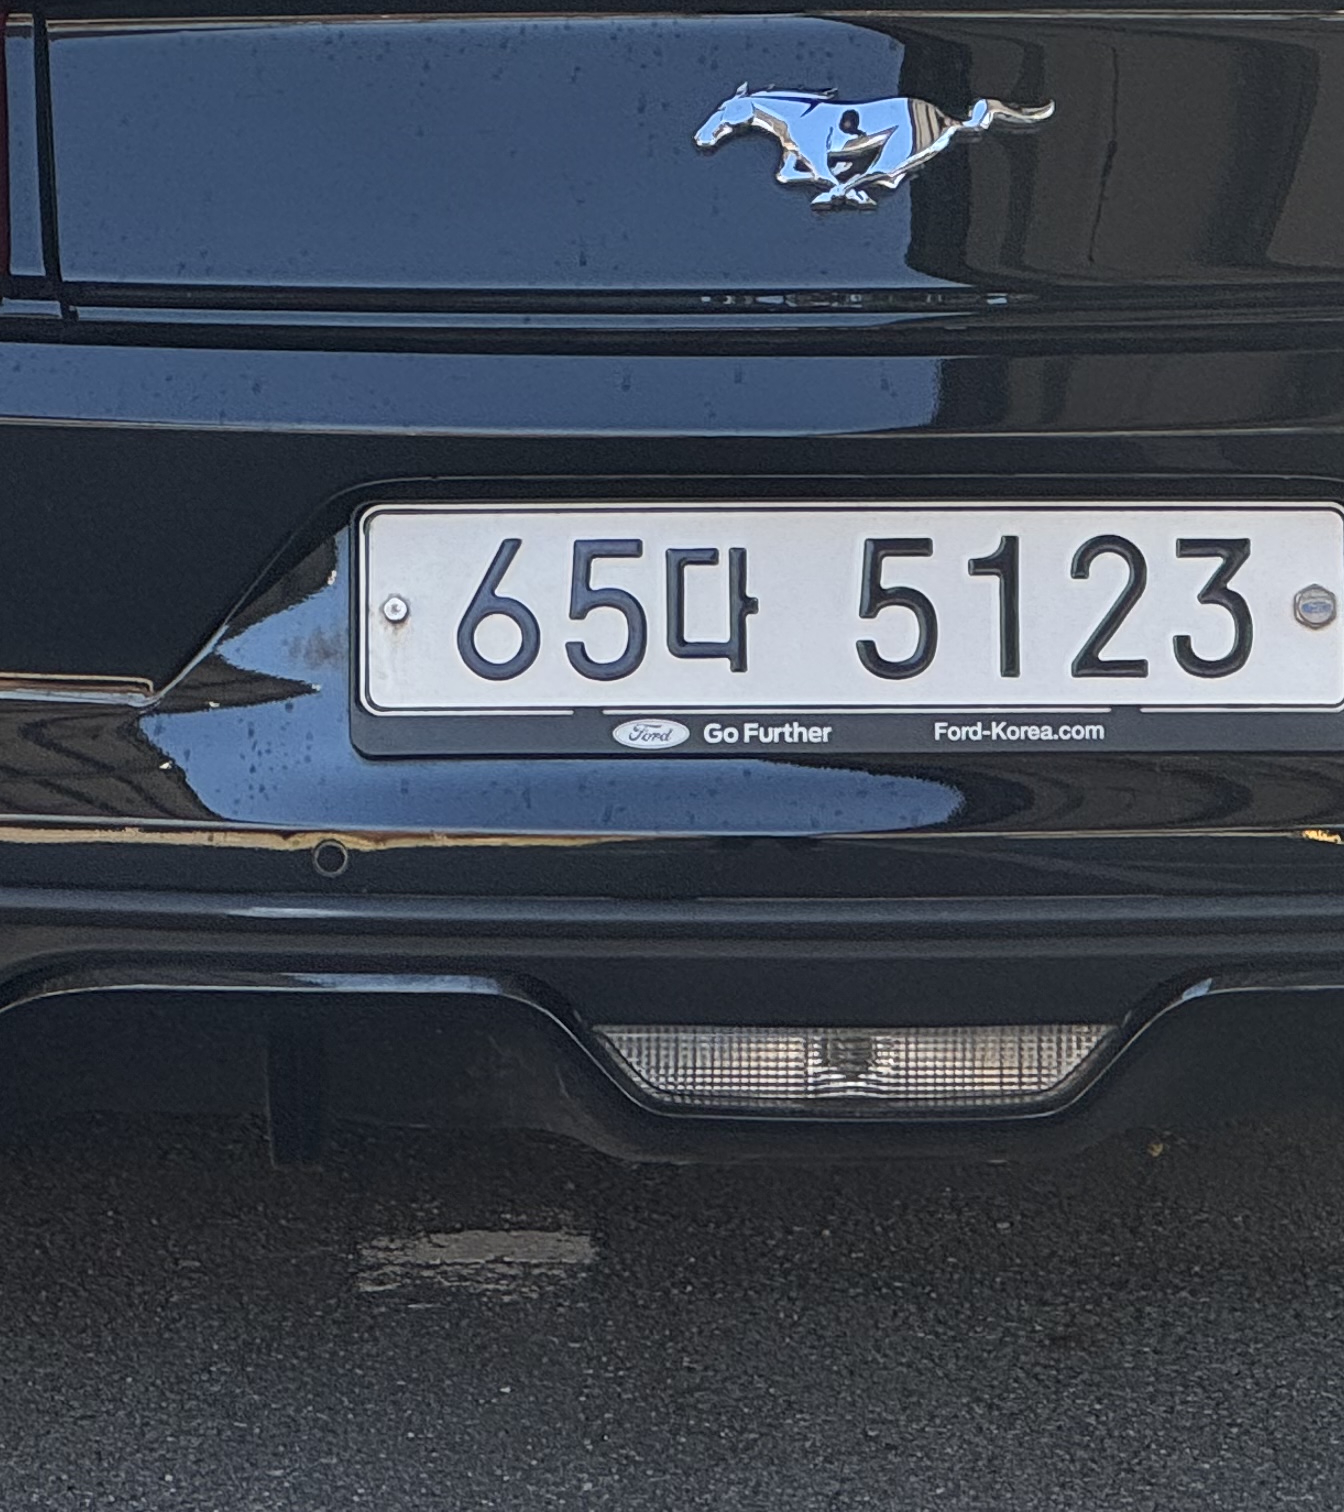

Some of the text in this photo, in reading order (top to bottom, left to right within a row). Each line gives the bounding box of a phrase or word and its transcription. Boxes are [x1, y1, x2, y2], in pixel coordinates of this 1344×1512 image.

[457, 534, 1254, 682] 65다 5123
[703, 721, 832, 744] Go Further
[934, 721, 1105, 742] Ford-Korea.com
